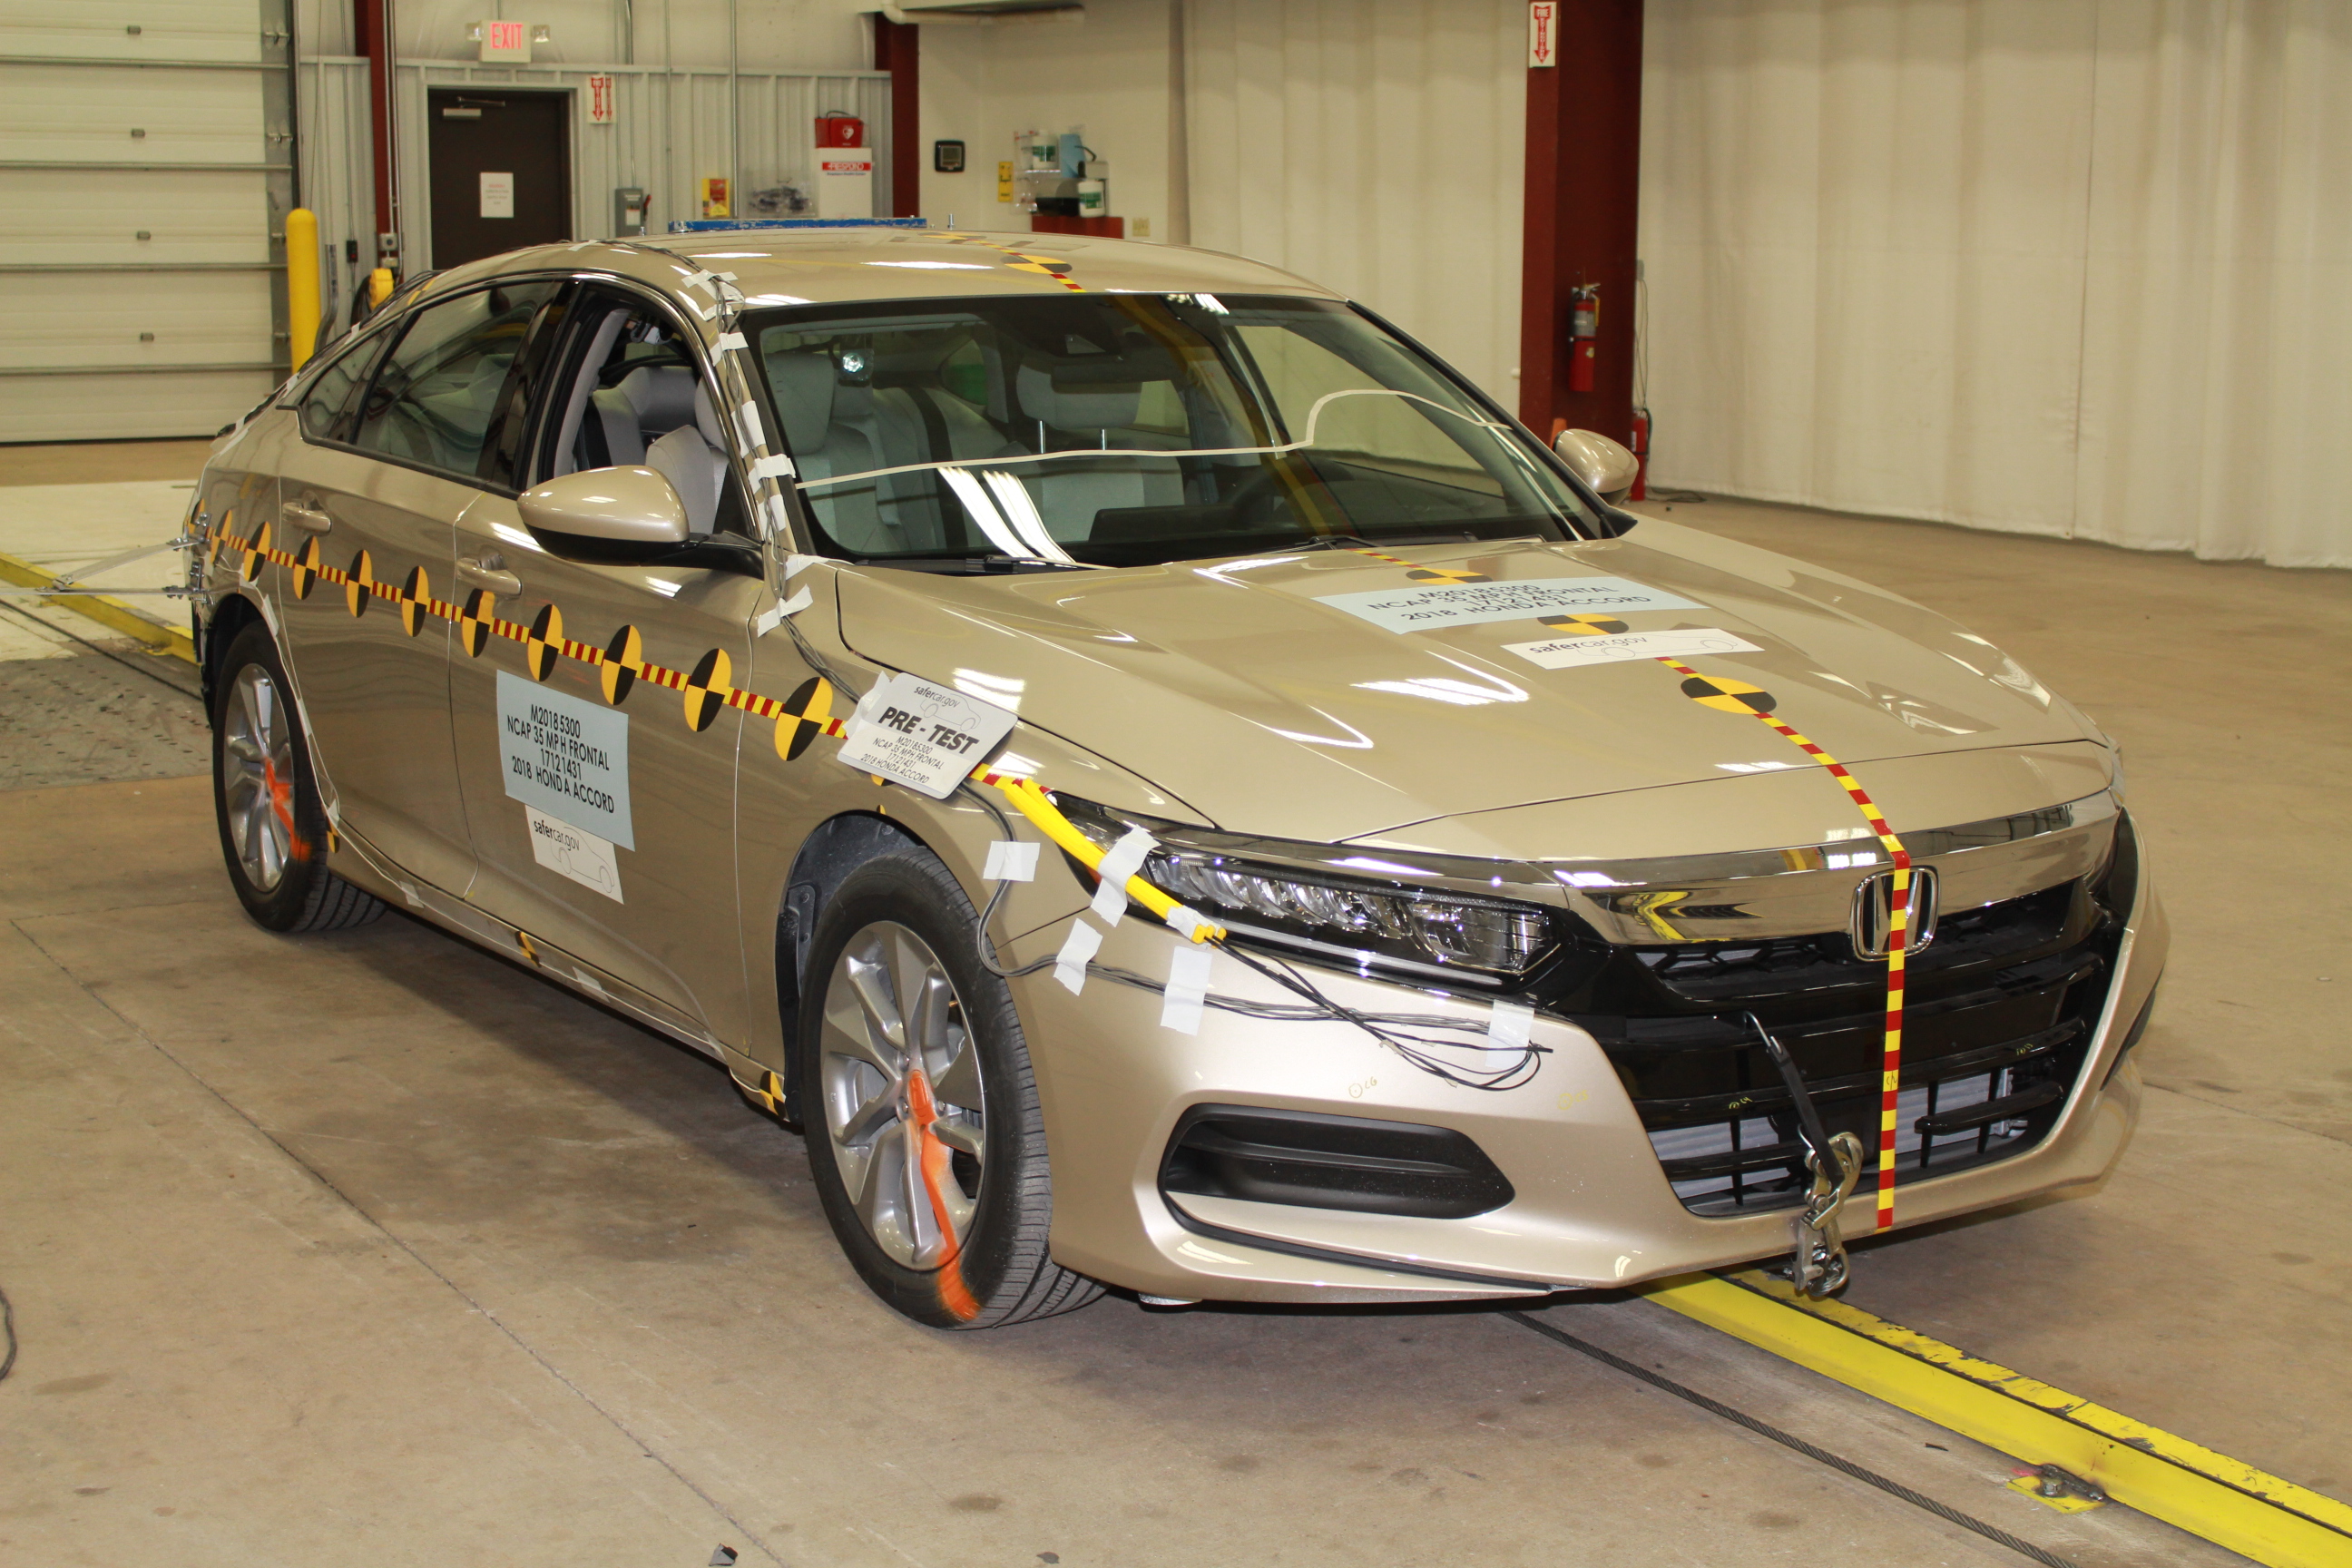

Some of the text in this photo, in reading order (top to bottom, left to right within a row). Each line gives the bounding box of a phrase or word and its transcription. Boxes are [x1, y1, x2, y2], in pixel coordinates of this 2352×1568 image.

[491, 23, 524, 49] EXIT
[1367, 599, 1432, 610] NCAP
[1469, 592, 1523, 600] MPH
[1523, 586, 1620, 596] FRONTAL
[1417, 585, 1541, 598] M20185300
[1465, 594, 1569, 606] 17121431
[1401, 596, 1651, 620] 2018 HONDA ACCORD
[1529, 637, 1648, 653] safercar.gov
[914, 686, 960, 708] safercar.gov
[877, 706, 922, 734] PRE
[927, 724, 980, 754] TEST
[507, 715, 609, 770] NCAP 35 MPH FRONTAL
[873, 738, 945, 769] NCAP 35 MPH FRONTAL
[896, 736, 933, 754] M20185300
[860, 753, 929, 784] 2018 HONDA ACCORD
[887, 753, 916, 768] 17121431
[512, 756, 614, 813] 2018 HONDA ACCORD
[534, 819, 580, 851] safercar.gov
